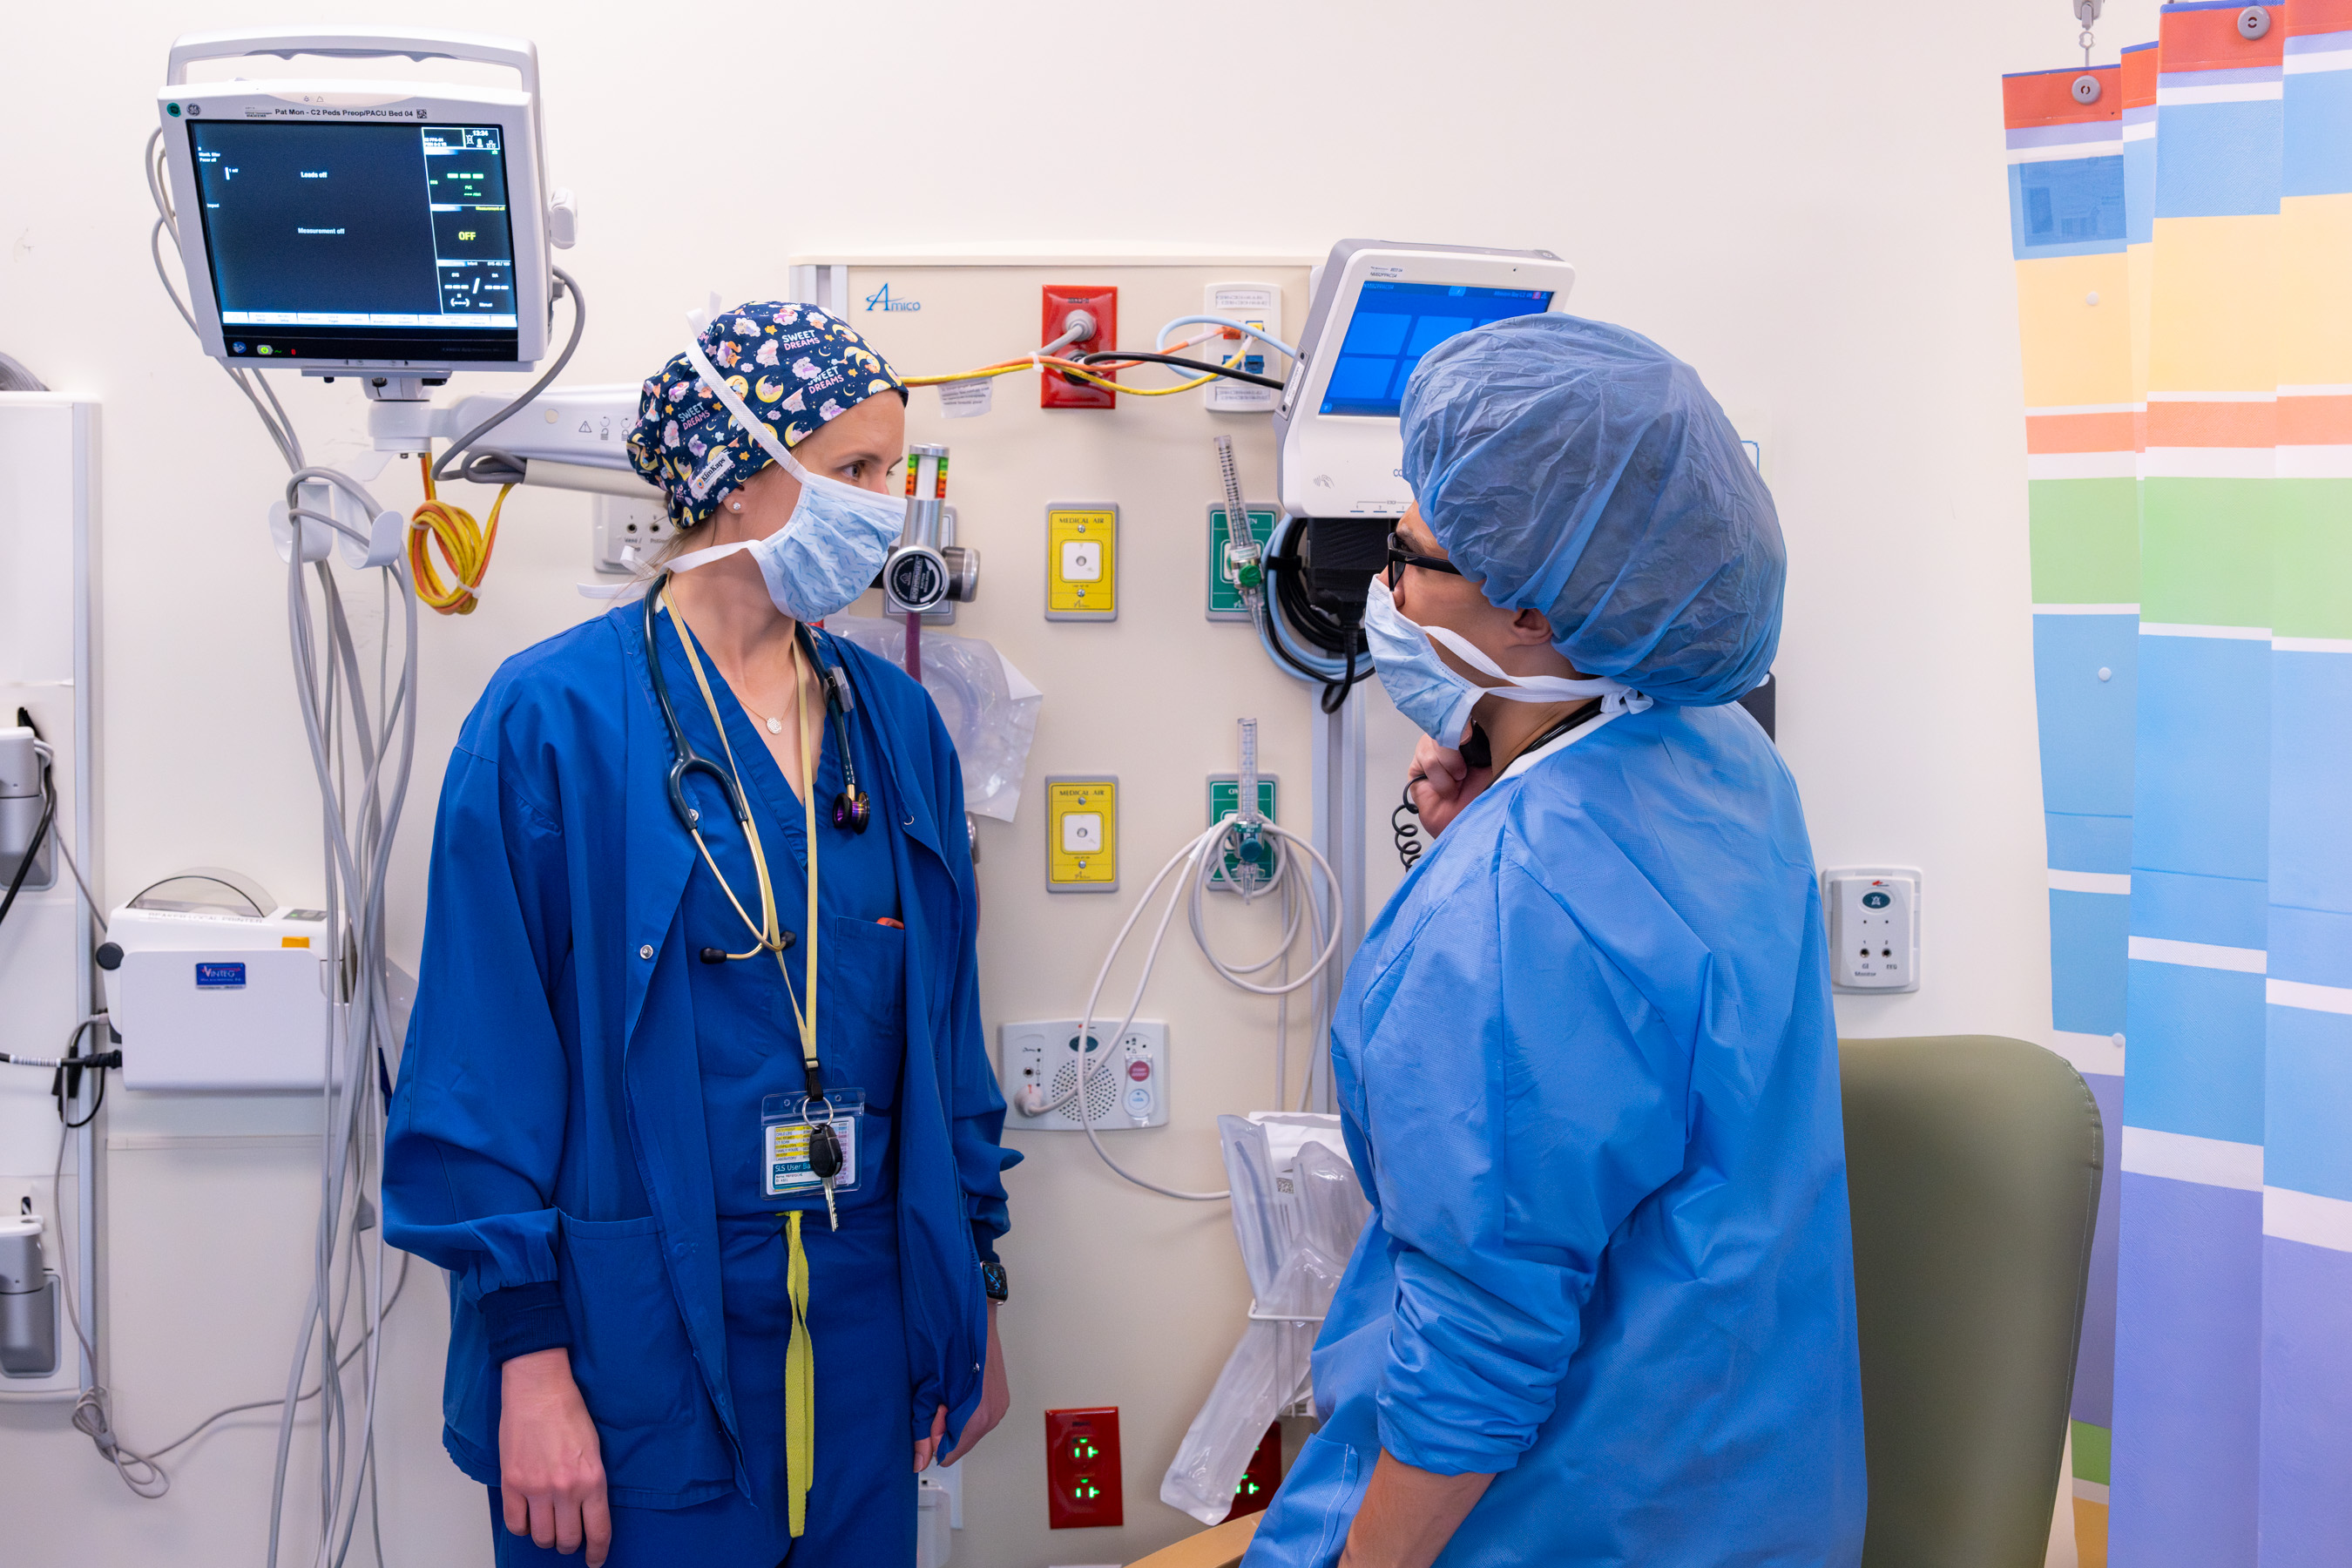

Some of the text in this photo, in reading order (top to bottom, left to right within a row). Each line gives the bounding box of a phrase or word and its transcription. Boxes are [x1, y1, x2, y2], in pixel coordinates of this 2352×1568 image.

[342, 109, 387, 118] Preop/PACU
[458, 232, 476, 240] OFF
[781, 329, 815, 343] SWEET
[783, 337, 821, 351] DREAMS
[808, 374, 845, 395] DREAMS
[678, 402, 705, 422] SWEET
[682, 409, 711, 430] DREAMS
[774, 1164, 786, 1173] SLS
[787, 1163, 801, 1172] User
